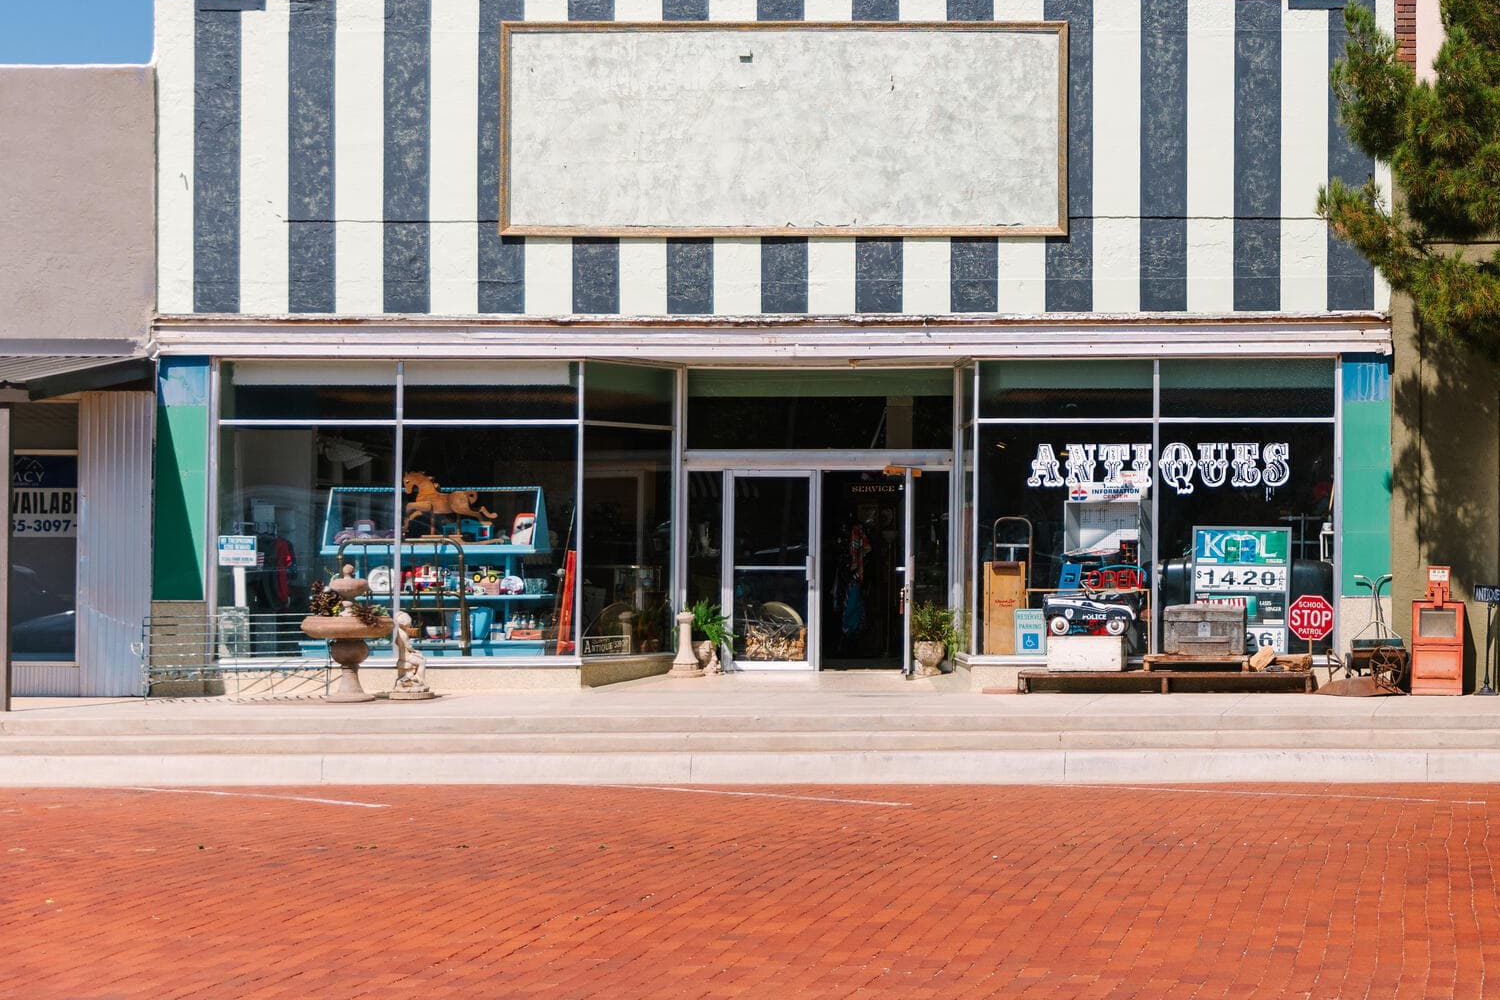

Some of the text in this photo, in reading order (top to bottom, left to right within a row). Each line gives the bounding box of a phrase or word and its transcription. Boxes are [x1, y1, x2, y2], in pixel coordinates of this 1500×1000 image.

[1027, 442, 1290, 495] ANTIQUES
[851, 485, 895, 493] SERVICE
[1087, 570, 1144, 589] OPEN
[1196, 569, 1275, 586] $14.20
[1299, 601, 1325, 609] SCHOOL
[1291, 609, 1332, 627] STOP
[1298, 627, 1323, 636] PATROL
